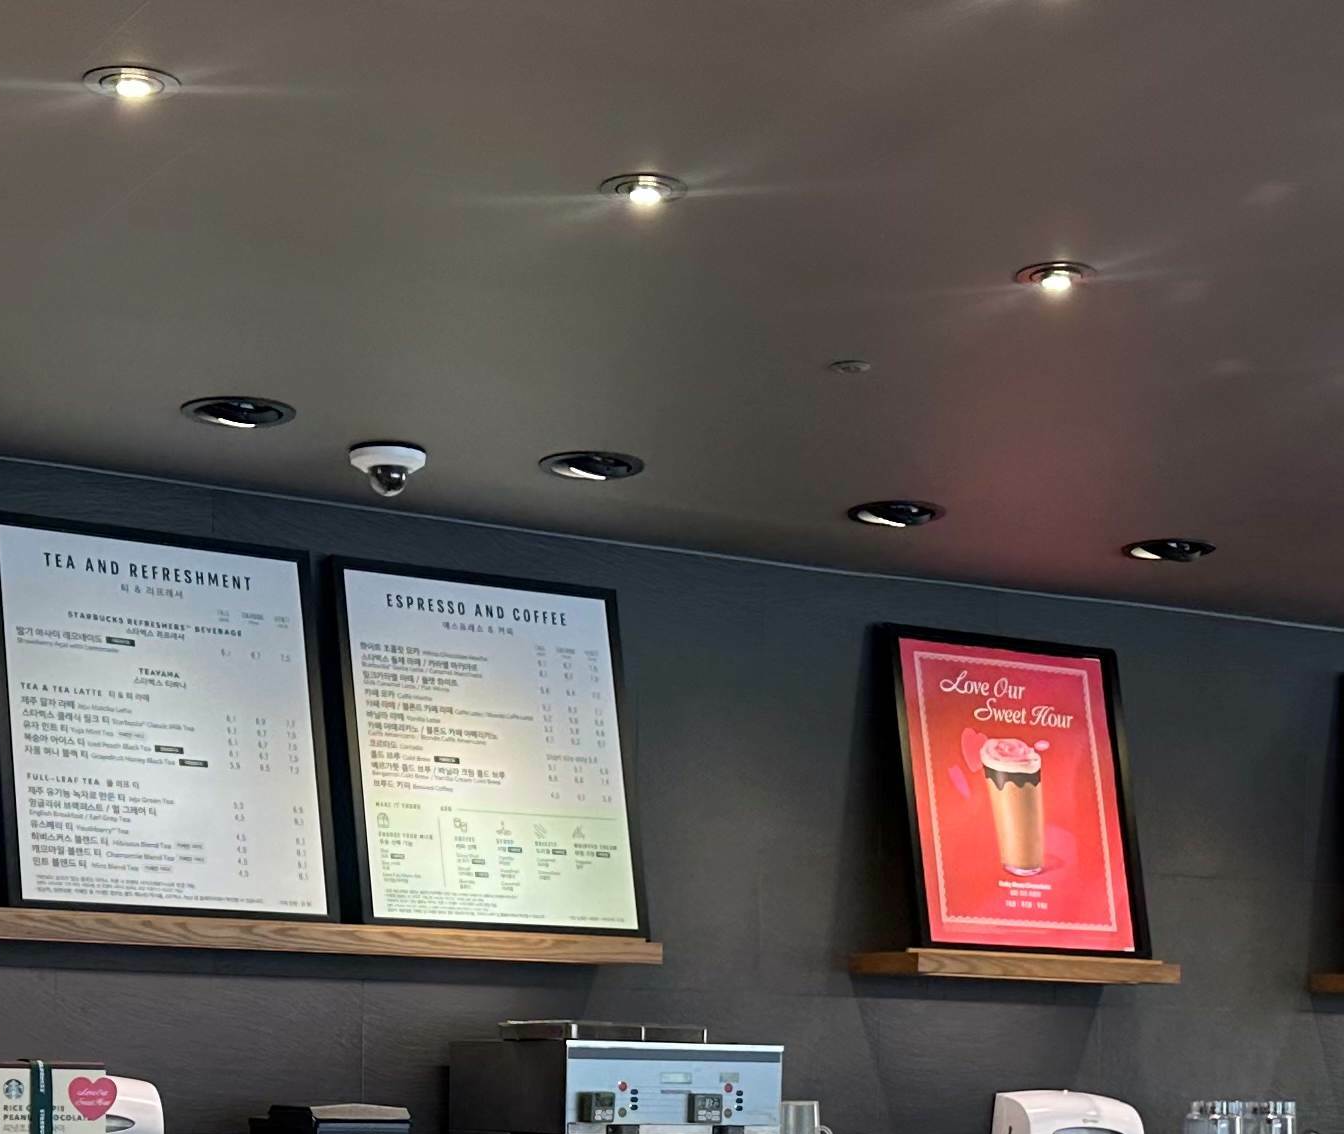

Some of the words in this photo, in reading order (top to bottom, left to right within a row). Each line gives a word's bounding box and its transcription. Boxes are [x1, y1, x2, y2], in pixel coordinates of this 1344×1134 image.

[44, 552, 76, 570] TEA
[85, 557, 120, 576] AND
[129, 563, 252, 592] REFRESHMENT
[67, 611, 124, 625] STARBUCKS
[386, 593, 466, 616] ESPRESSO
[474, 603, 505, 619] AND
[513, 607, 568, 627] COFFEE
[20, 682, 38, 691] TEA
[52, 685, 70, 694] TEA
[74, 688, 103, 697] LATTE
[939, 670, 990, 697] Love
[993, 677, 1026, 699] Our
[974, 698, 1027, 725] Sweet
[1029, 705, 1074, 729] Hour
[82, 776, 100, 785] TEA
